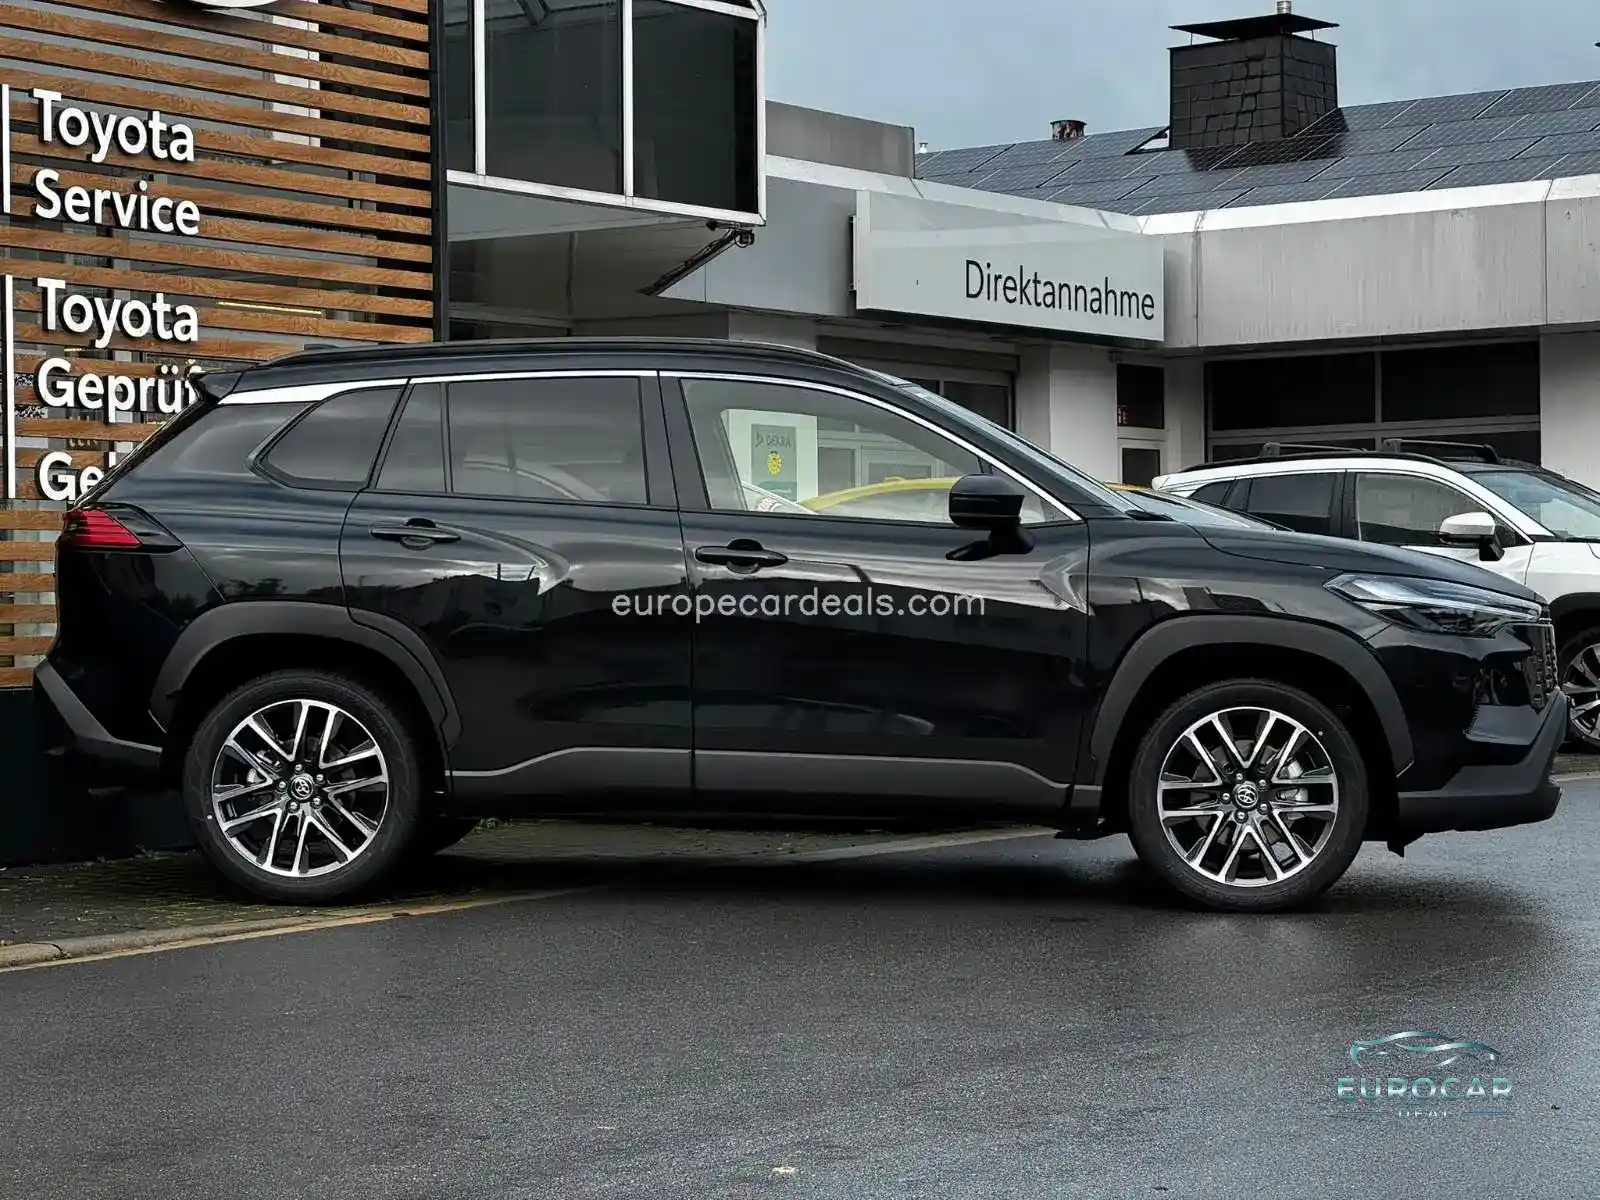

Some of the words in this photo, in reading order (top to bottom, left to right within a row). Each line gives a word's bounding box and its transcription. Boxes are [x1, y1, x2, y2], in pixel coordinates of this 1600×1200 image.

[33, 88, 195, 163] Toyota
[35, 169, 200, 236] Service
[37, 278, 199, 348] Toyota
[965, 259, 1155, 320] Direktannahme
[39, 451, 116, 501] Ge
